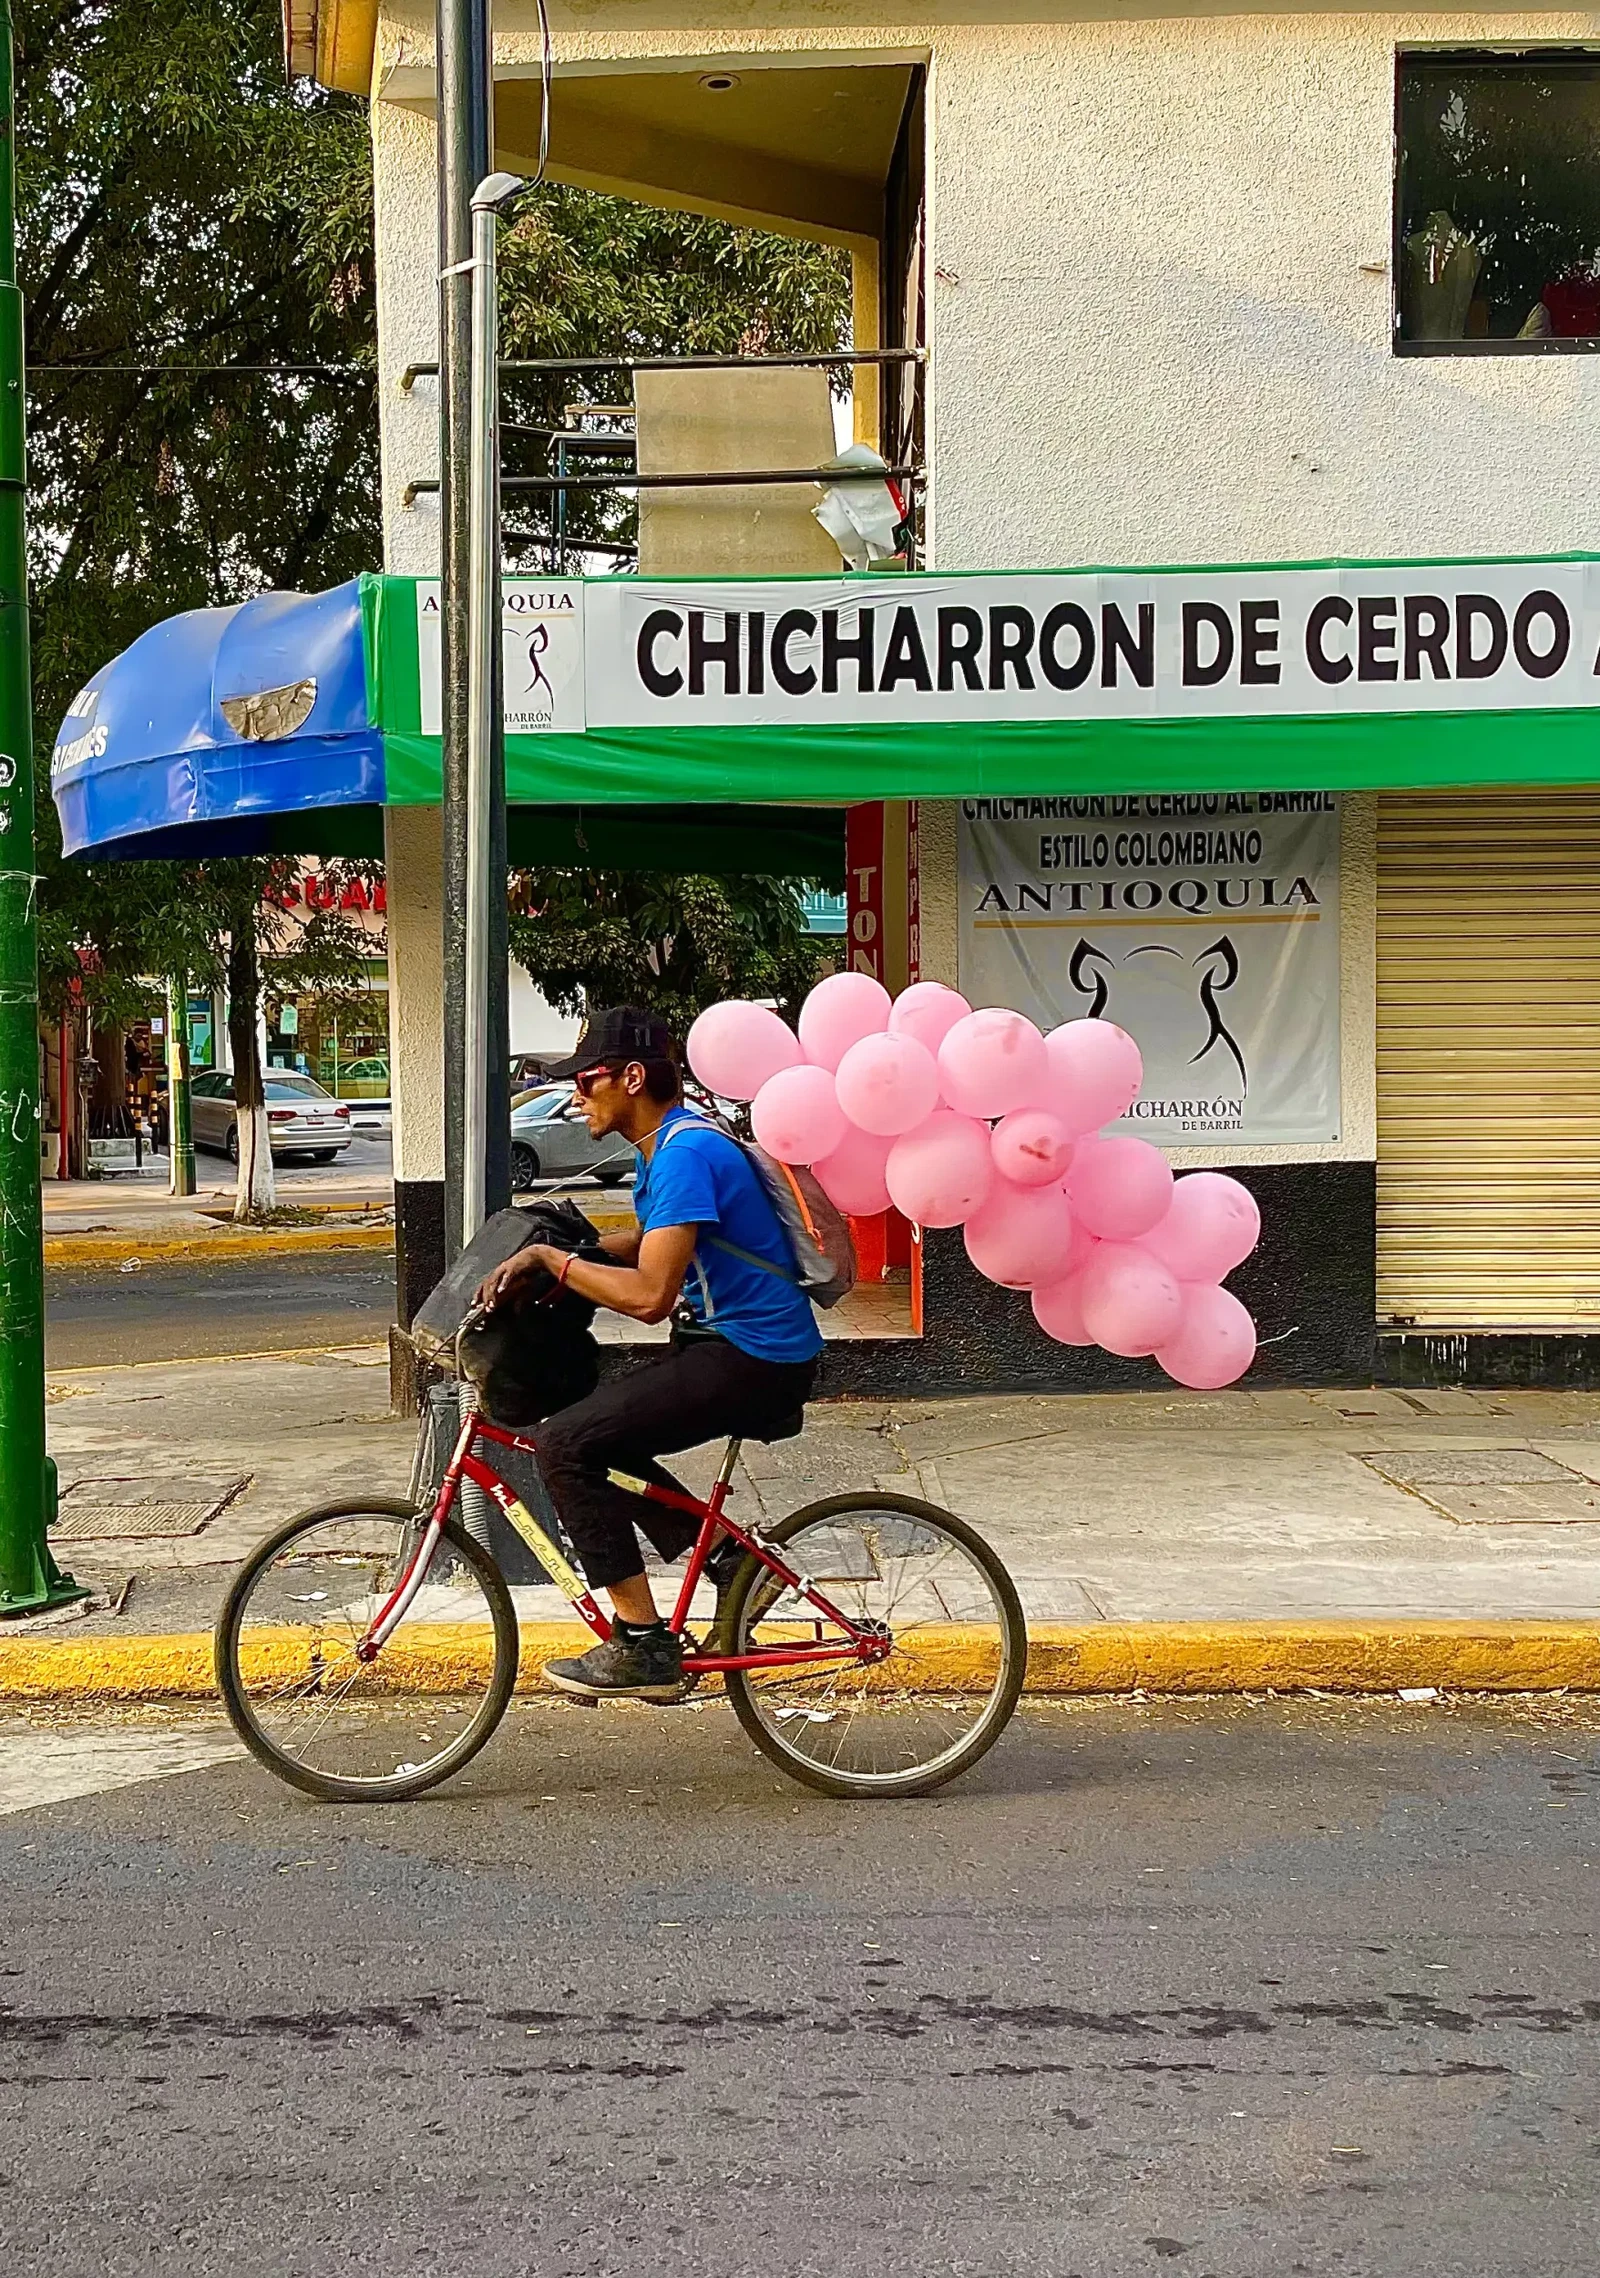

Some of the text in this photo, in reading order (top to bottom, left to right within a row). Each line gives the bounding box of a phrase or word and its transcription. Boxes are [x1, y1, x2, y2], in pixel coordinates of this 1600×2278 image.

[422, 593, 575, 614] AQUIA
[637, 602, 1155, 697] CHICHARRON
[1182, 600, 1281, 687] DE
[1306, 590, 1570, 685] CERDO
[504, 710, 552, 722] HARRÓN
[1112, 795, 1140, 817] DE
[1146, 793, 1218, 816] CERDO
[1225, 792, 1253, 814] AL
[1259, 791, 1335, 813] BARRIL
[1040, 829, 1262, 868] ESTILO COLOMBIANO
[974, 876, 1321, 914] ANTIOQUIA
[1119, 1095, 1244, 1119] ICHARRÓN
[1182, 1120, 1244, 1131] DE BARRIL
